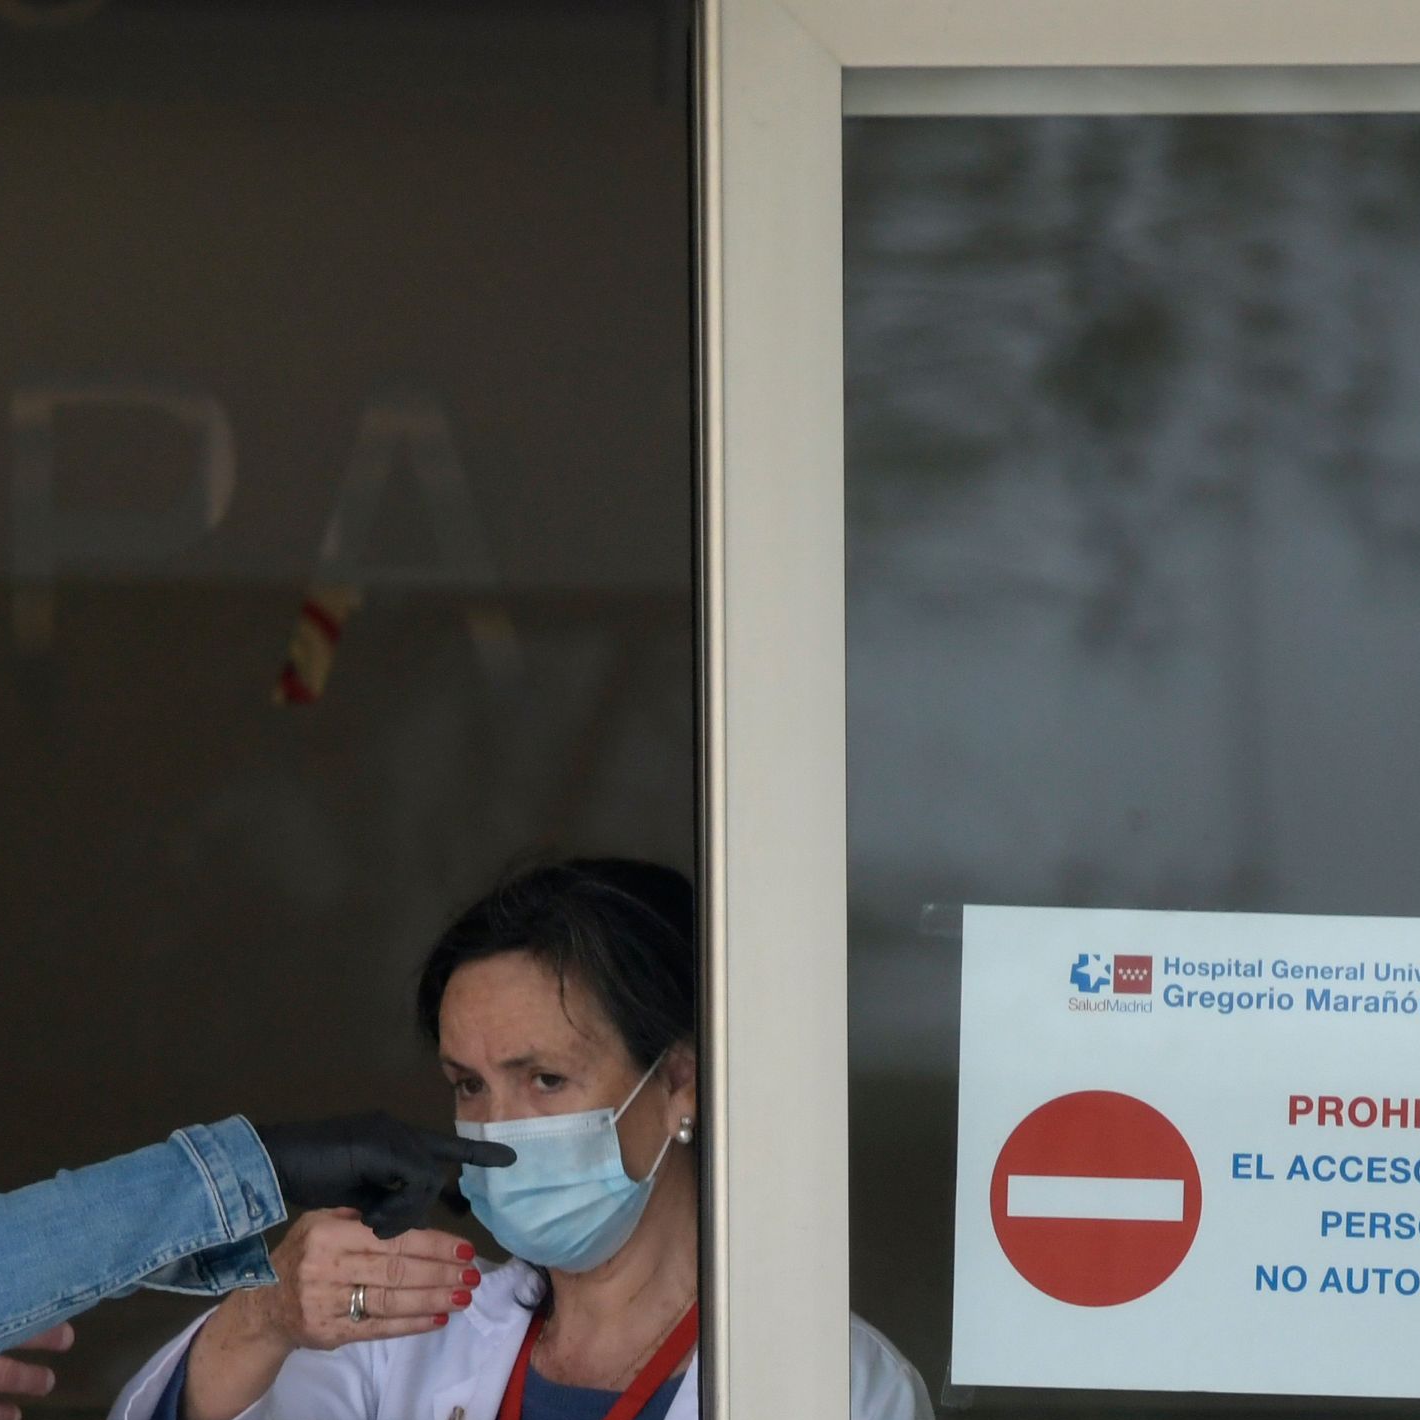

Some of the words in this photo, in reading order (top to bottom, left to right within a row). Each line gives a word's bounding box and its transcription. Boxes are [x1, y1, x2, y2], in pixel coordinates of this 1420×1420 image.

[1163, 956, 1263, 981] Hospital
[1271, 958, 1365, 982] General
[1068, 996, 1153, 1014] SaludMadrid
[1163, 983, 1294, 1015] Gregorio
[1232, 1153, 1274, 1180] EL
[1255, 1265, 1308, 1293] NO
